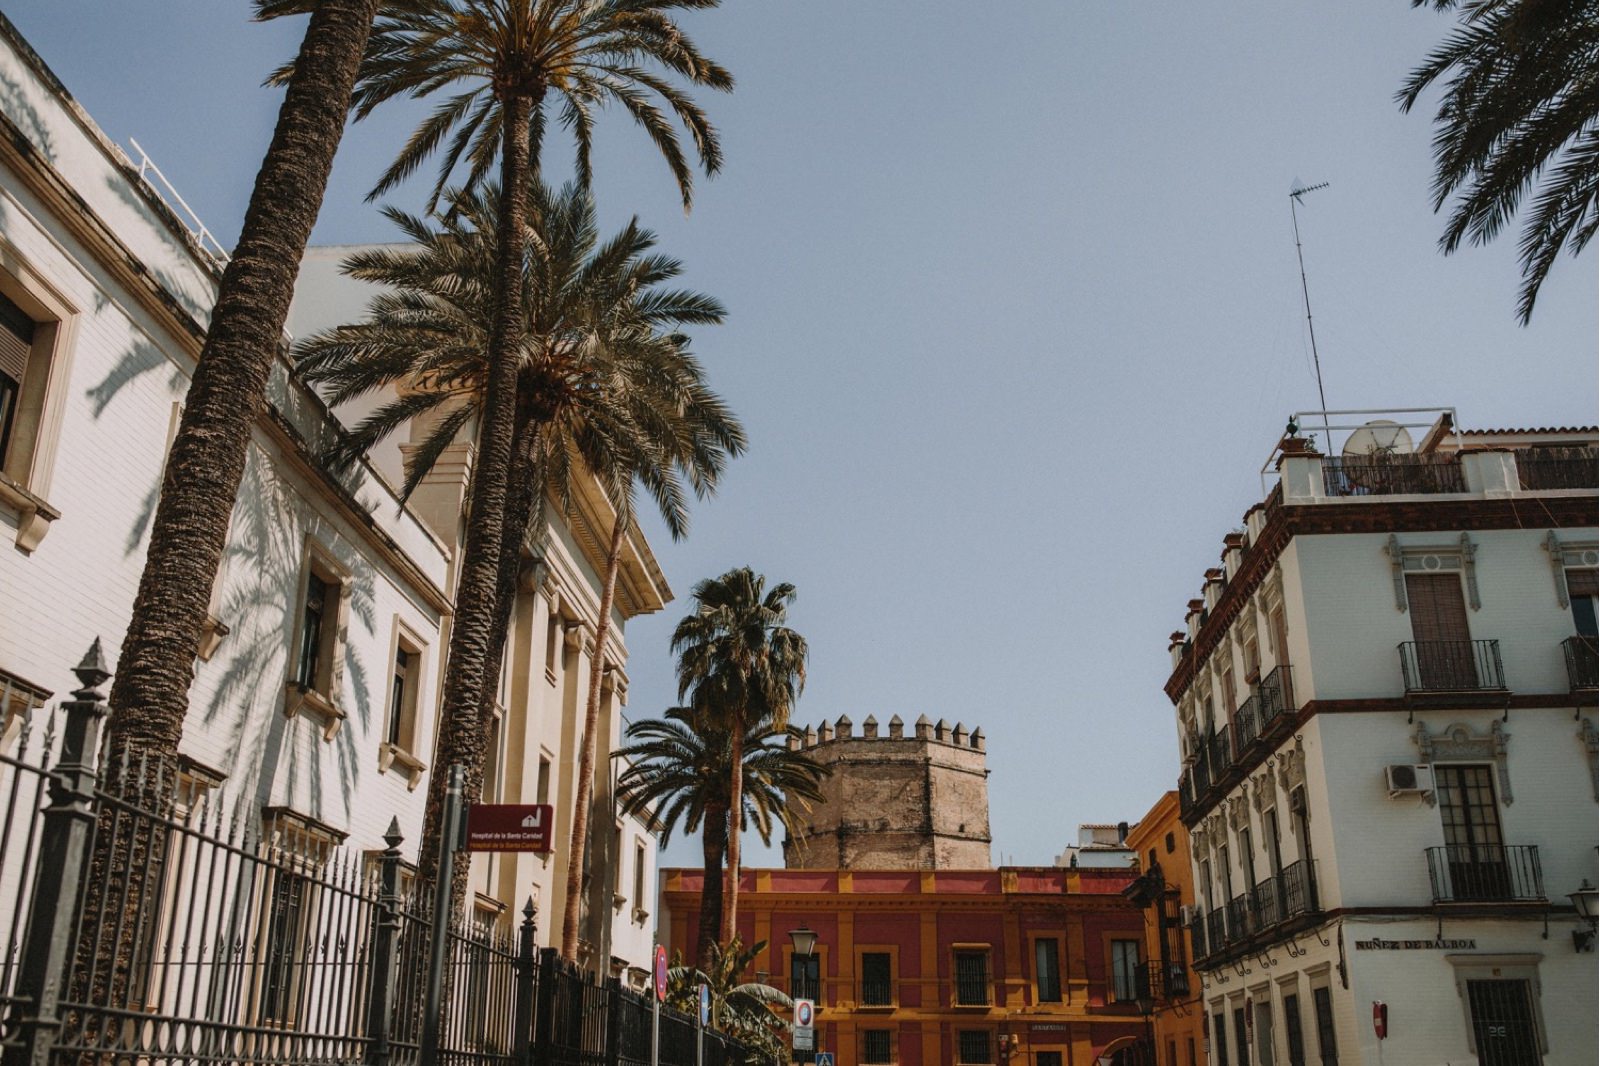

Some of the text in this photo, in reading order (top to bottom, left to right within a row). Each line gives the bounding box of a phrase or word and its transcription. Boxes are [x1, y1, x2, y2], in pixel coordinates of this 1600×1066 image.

[471, 832, 493, 840] Hospital
[1355, 938, 1476, 950] NUÑEZ DE BALBOA
